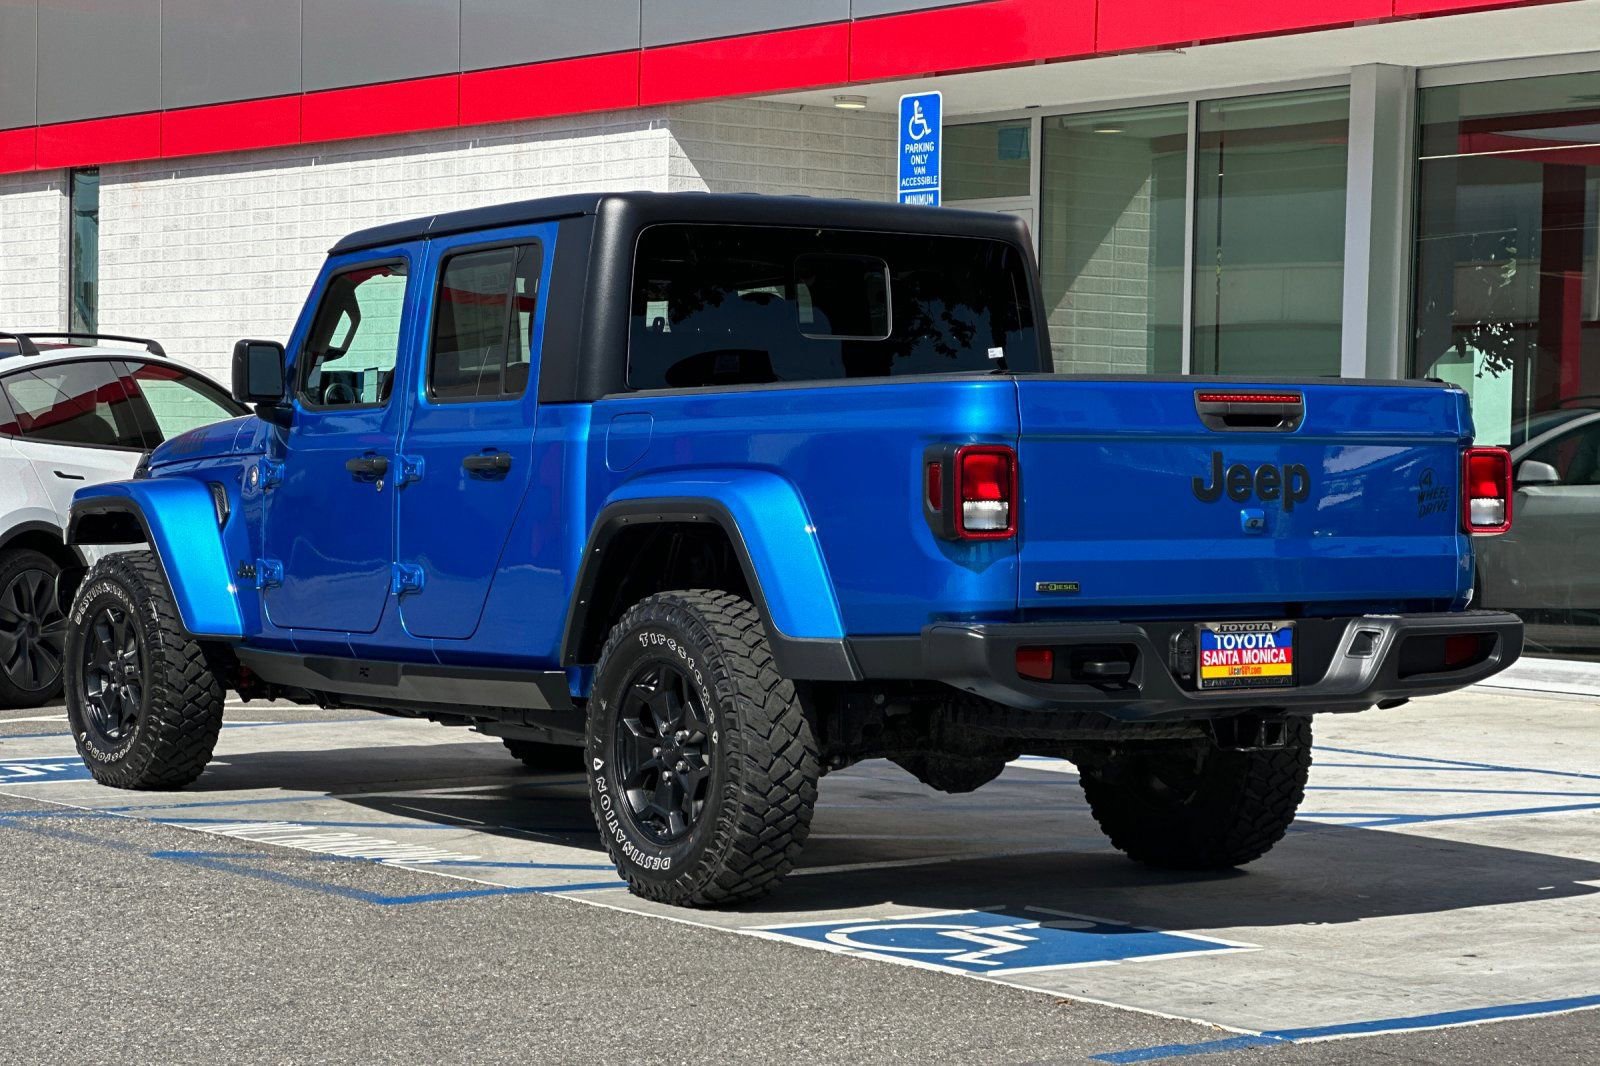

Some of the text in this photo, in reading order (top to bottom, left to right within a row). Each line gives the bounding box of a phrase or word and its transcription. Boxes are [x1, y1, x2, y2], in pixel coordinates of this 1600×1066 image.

[905, 142, 934, 153] PARKING
[911, 154, 928, 165] ONLY
[913, 166, 926, 175] VAN
[902, 176, 937, 187] ACCESSIBLE
[905, 194, 934, 205] MINIMUM
[1191, 451, 1311, 513] Jeep
[1417, 485, 1450, 502] WHEEL
[1417, 501, 1448, 518] DRIVE
[1222, 623, 1271, 631] TOYOTA
[1214, 633, 1276, 650] TOYOTA
[1203, 648, 1287, 666] SANTA MONICA
[595, 777, 671, 870] DESTINATION
